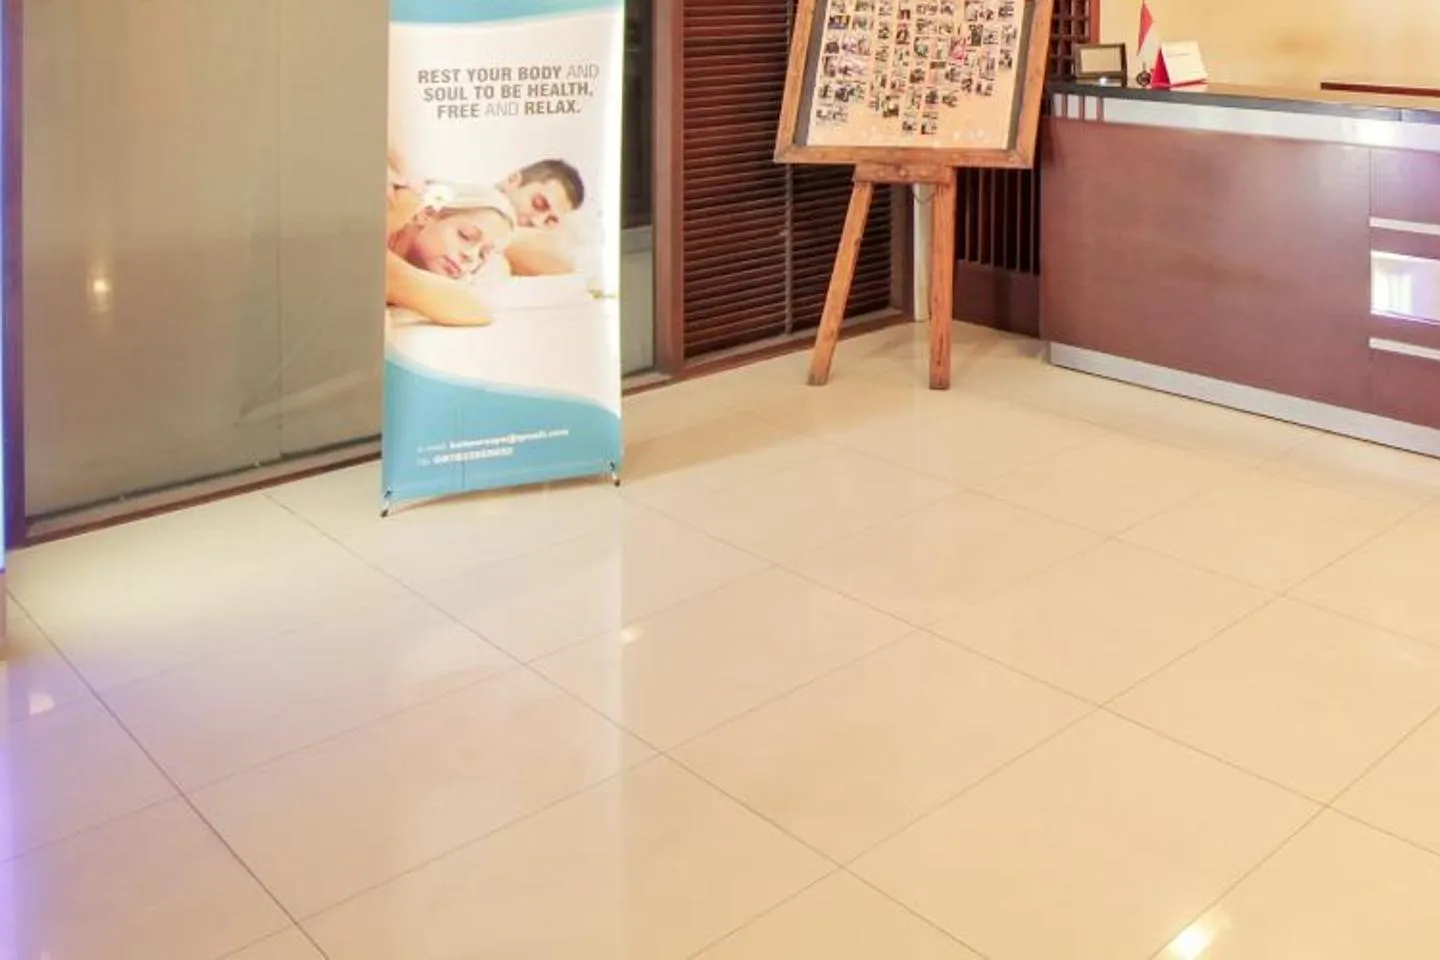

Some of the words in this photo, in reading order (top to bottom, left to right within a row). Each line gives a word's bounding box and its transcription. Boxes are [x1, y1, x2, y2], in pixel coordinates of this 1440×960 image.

[418, 69, 461, 84] REST
[467, 67, 512, 83] YOUR
[518, 65, 562, 81] BODY
[566, 63, 600, 79] AND
[423, 87, 468, 102] SOUL
[473, 85, 495, 100] TO
[501, 84, 522, 99] BE
[437, 103, 480, 120] FREE
[484, 102, 519, 117] AND
[524, 100, 582, 116] RELAX.
